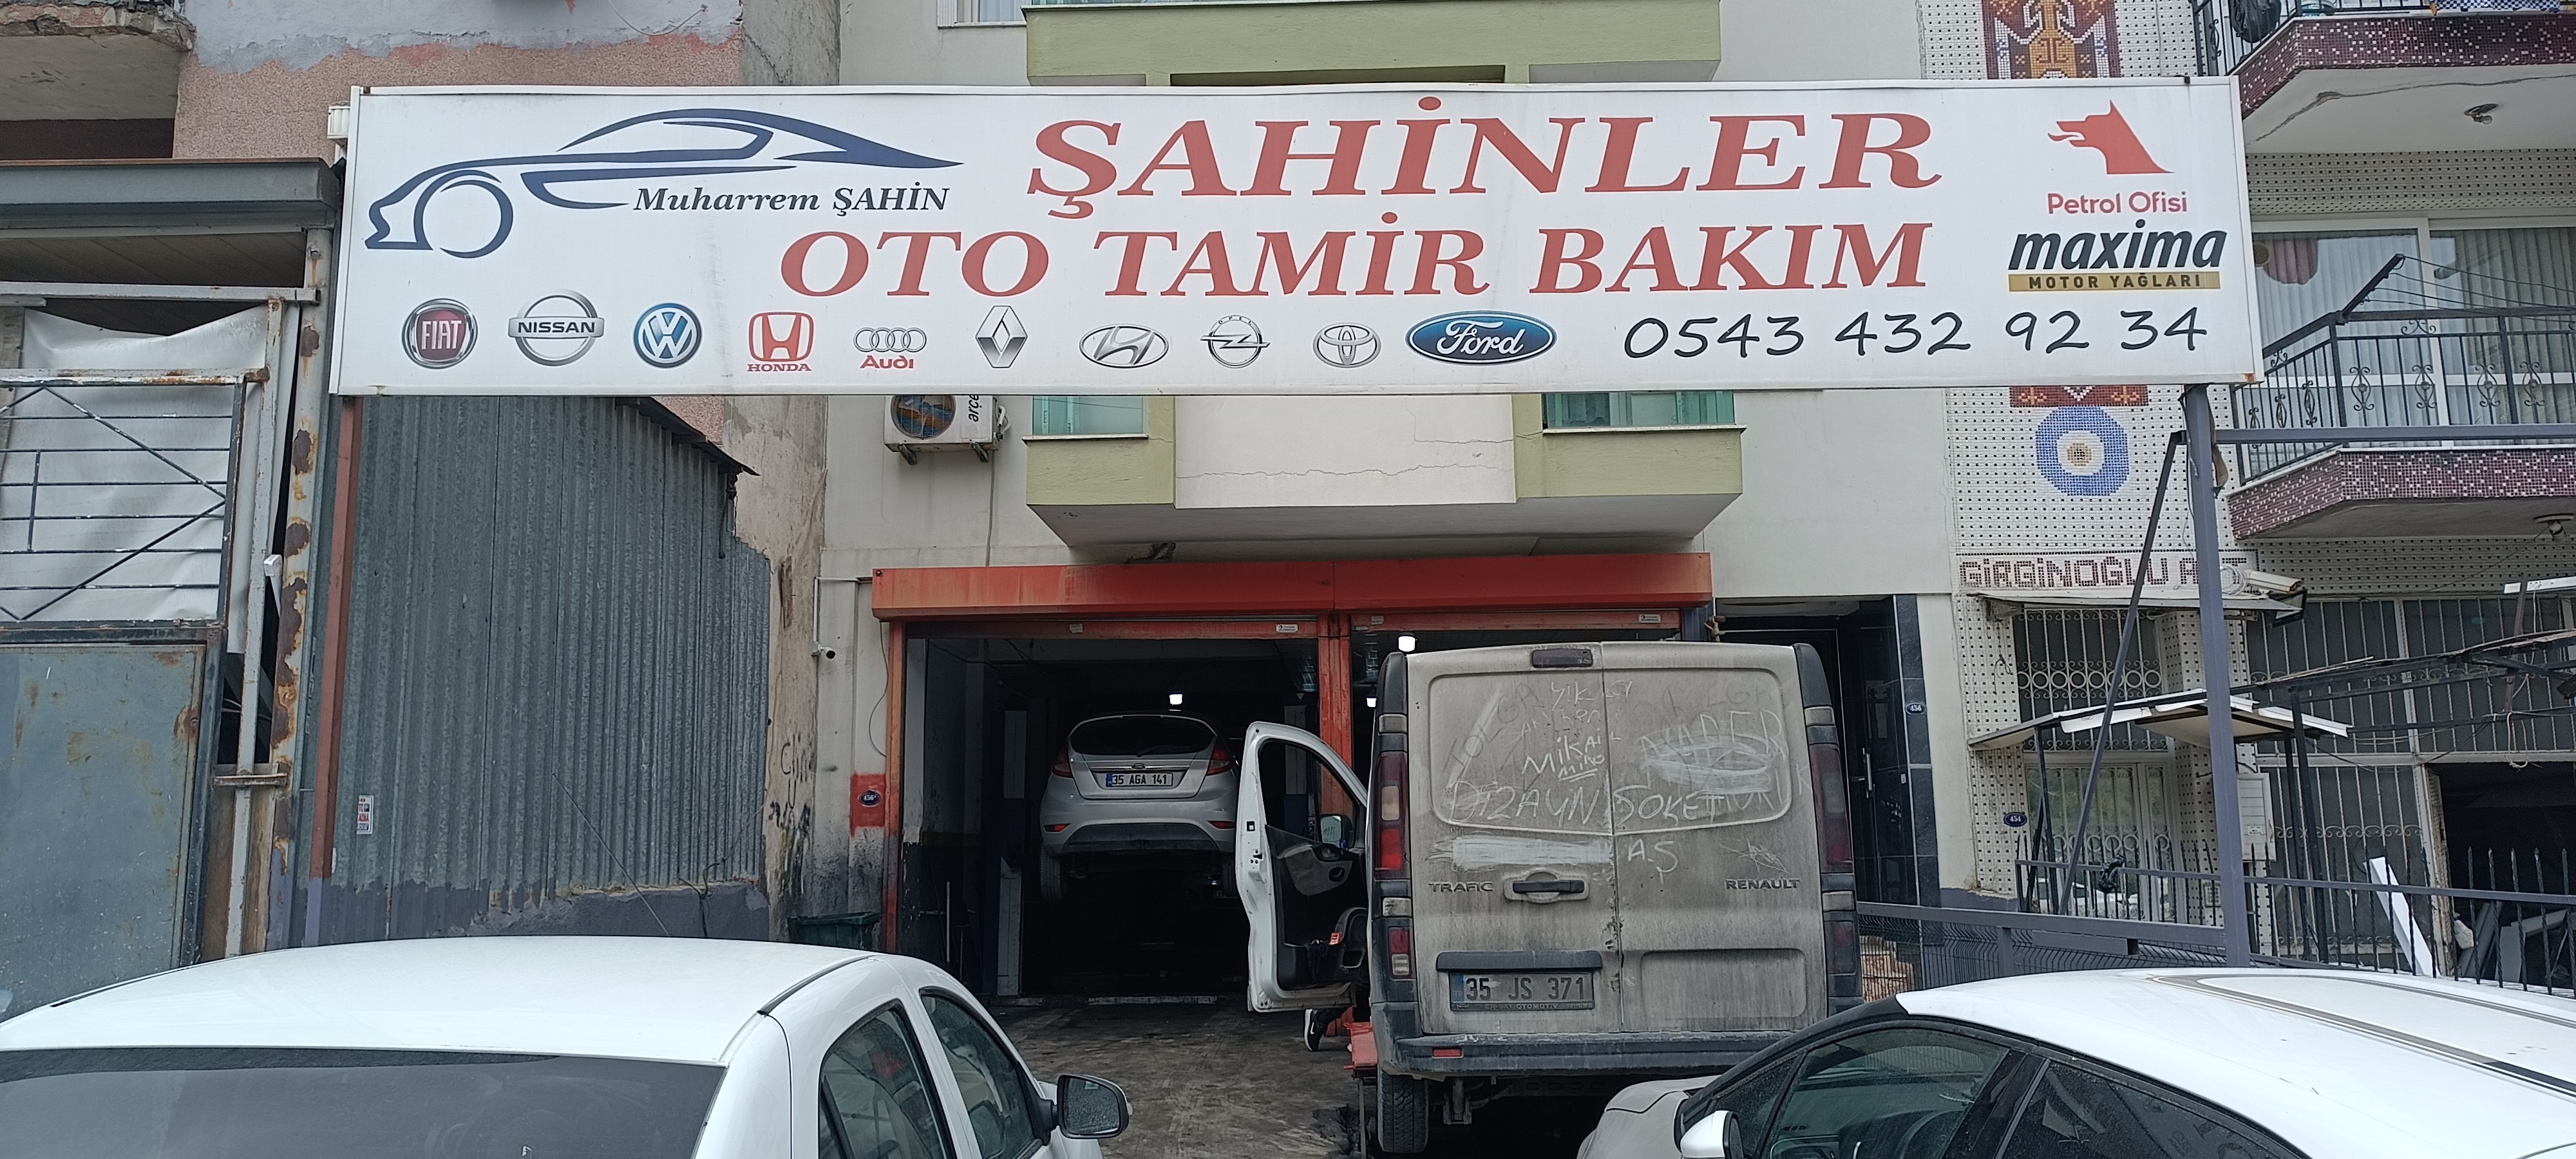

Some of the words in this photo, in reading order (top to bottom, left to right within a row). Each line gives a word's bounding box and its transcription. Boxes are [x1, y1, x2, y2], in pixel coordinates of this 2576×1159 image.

[1028, 96, 1942, 219] ŞAHİNLER
[632, 186, 820, 211] Muharrem
[832, 181, 951, 217] ŞAHİN
[2047, 193, 2122, 214] Petrol
[2128, 191, 2188, 212] Ofisi
[781, 231, 1049, 297] OTO
[1094, 211, 1490, 297] TAMİR
[1528, 223, 1933, 294] BAKIM
[2007, 219, 2228, 270] maxima
[2029, 276, 2099, 289] MOTOR
[2109, 271, 2201, 288] YAĞLARI
[421, 319, 462, 350] FIAT
[518, 321, 596, 334] NISSAN
[1436, 320, 1525, 355] Ford
[1624, 313, 1805, 359] 0543
[1833, 311, 1972, 356] 432
[2004, 310, 2090, 354] 92
[2119, 306, 2208, 351] 34
[747, 363, 811, 372] HONDA
[860, 355, 914, 369] Audi
[2179, 558, 2248, 585] AT
[1112, 774, 1124, 785] 35
[1128, 774, 1146, 785] AGA
[1151, 773, 1167, 785] 141
[1428, 881, 1494, 893] TRAFIC
[1725, 878, 1801, 891] RENAULT
[1466, 977, 1492, 1001] 35
[1508, 977, 1533, 1001] JS
[1547, 976, 1585, 1000] 371
